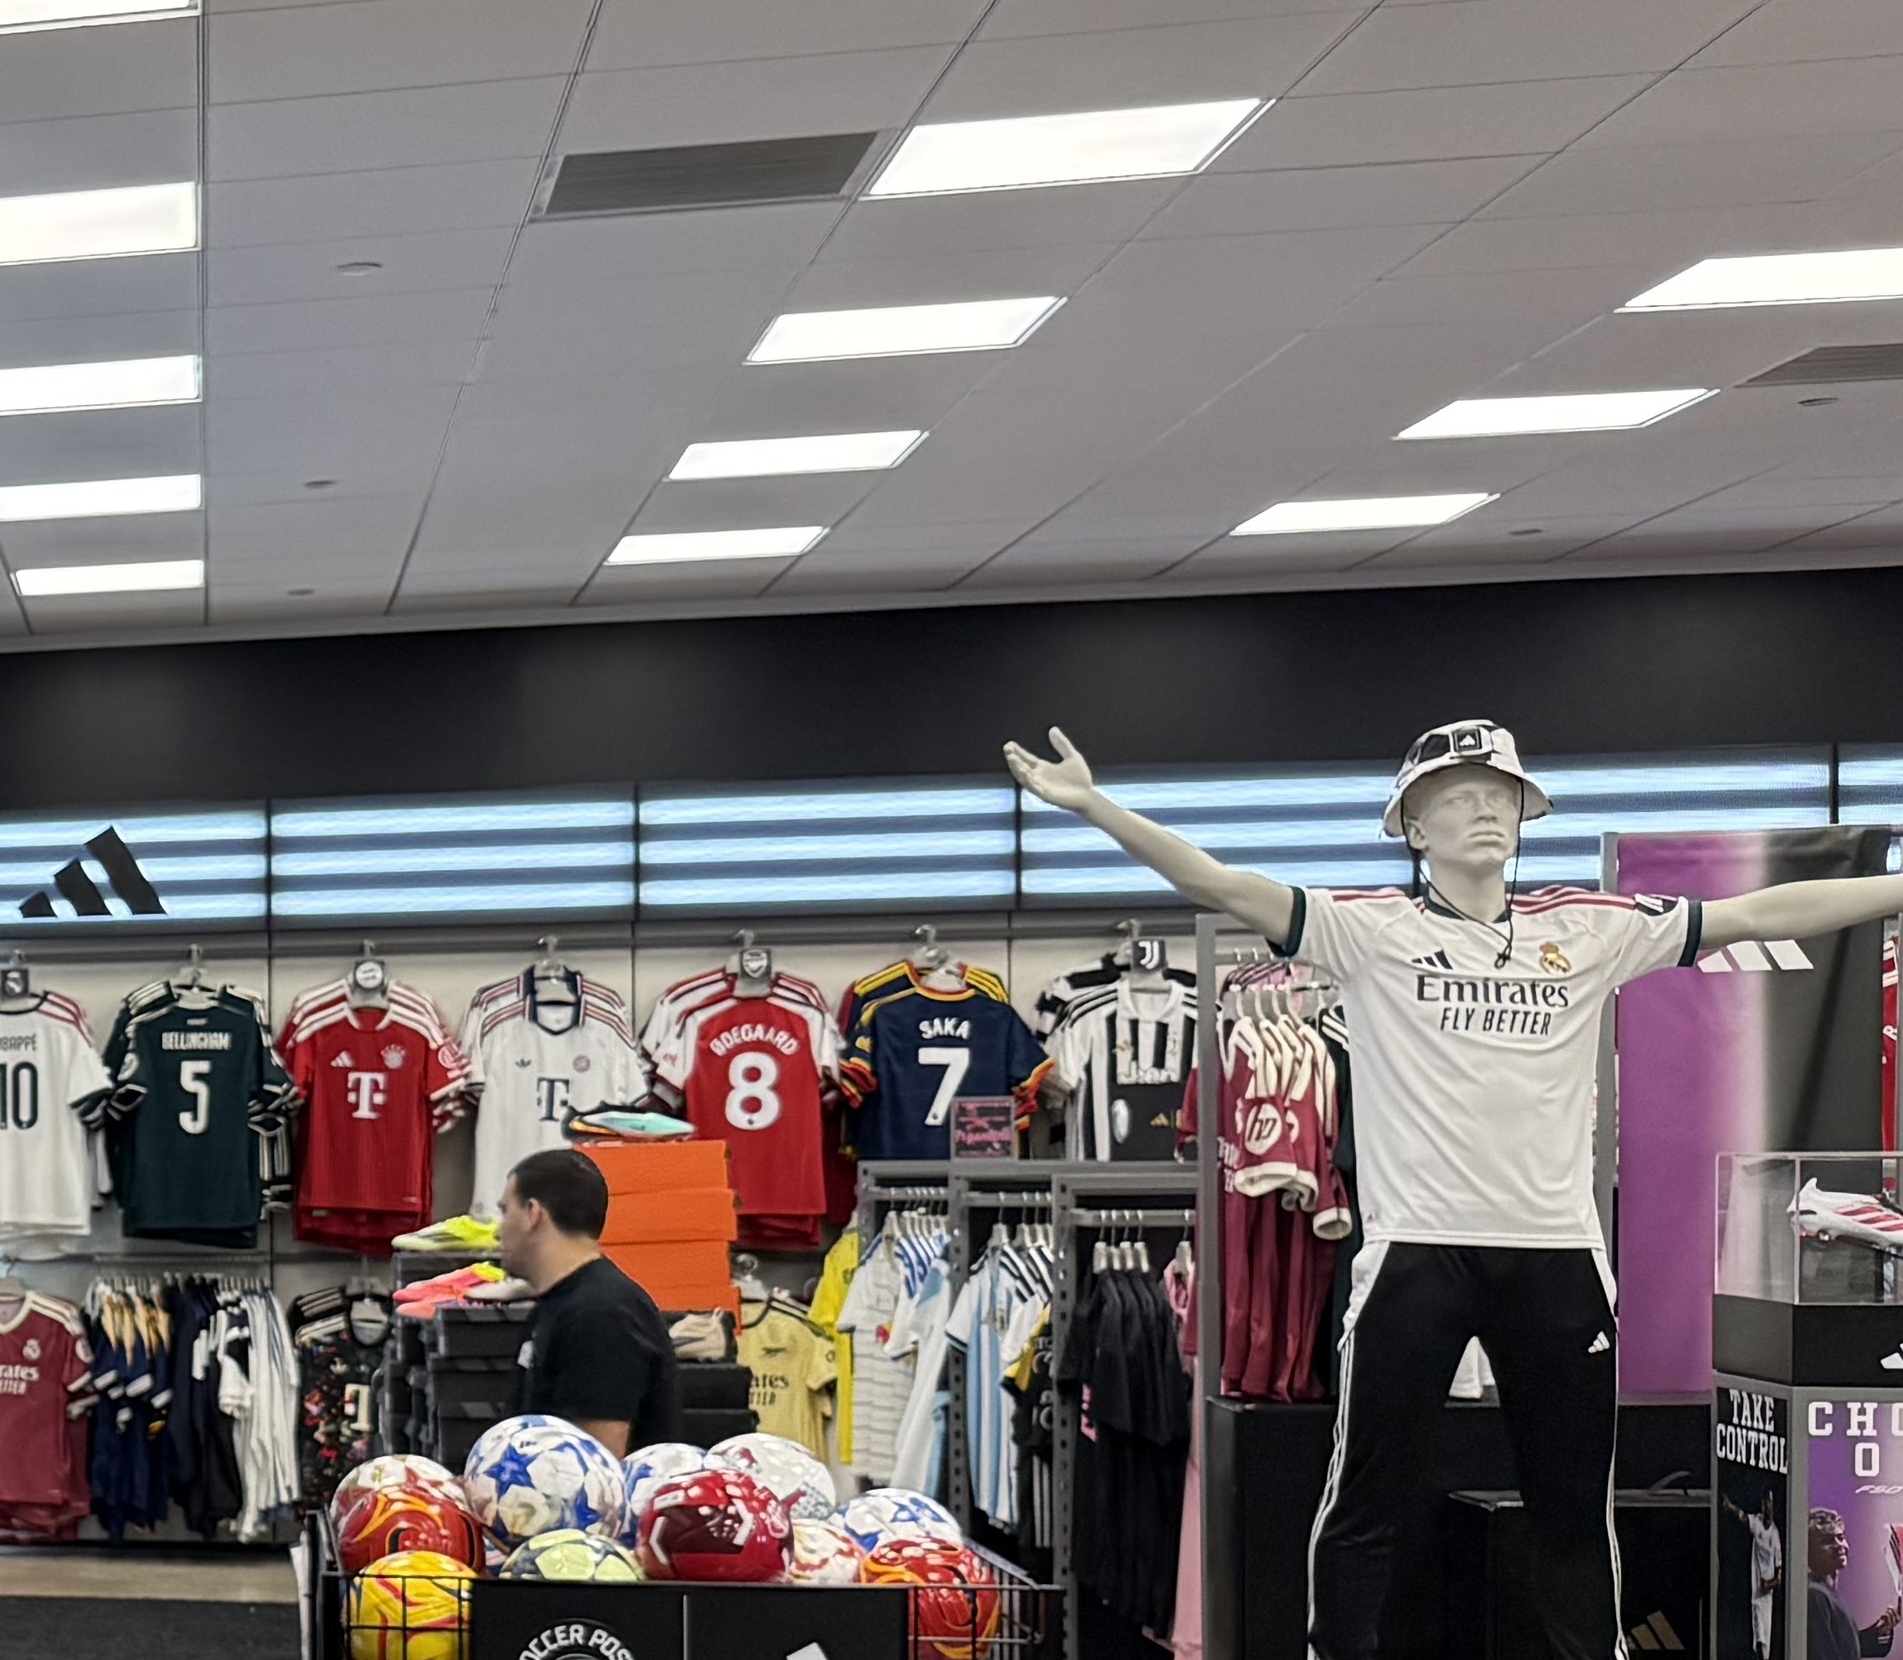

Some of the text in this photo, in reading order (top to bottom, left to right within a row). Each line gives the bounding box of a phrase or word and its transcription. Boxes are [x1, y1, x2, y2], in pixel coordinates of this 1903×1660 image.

[1416, 974, 1569, 1008] Emirates
[161, 1032, 231, 1051] BELLINGHAM
[918, 1017, 971, 1040] SAKA
[1440, 1007, 1552, 1037] FLY BETTER
[179, 1060, 212, 1135] 5
[725, 1052, 781, 1131] 8
[918, 1047, 971, 1126] 7
[1729, 1388, 1775, 1433] TAKE
[1716, 1423, 1788, 1475] CONTROL
